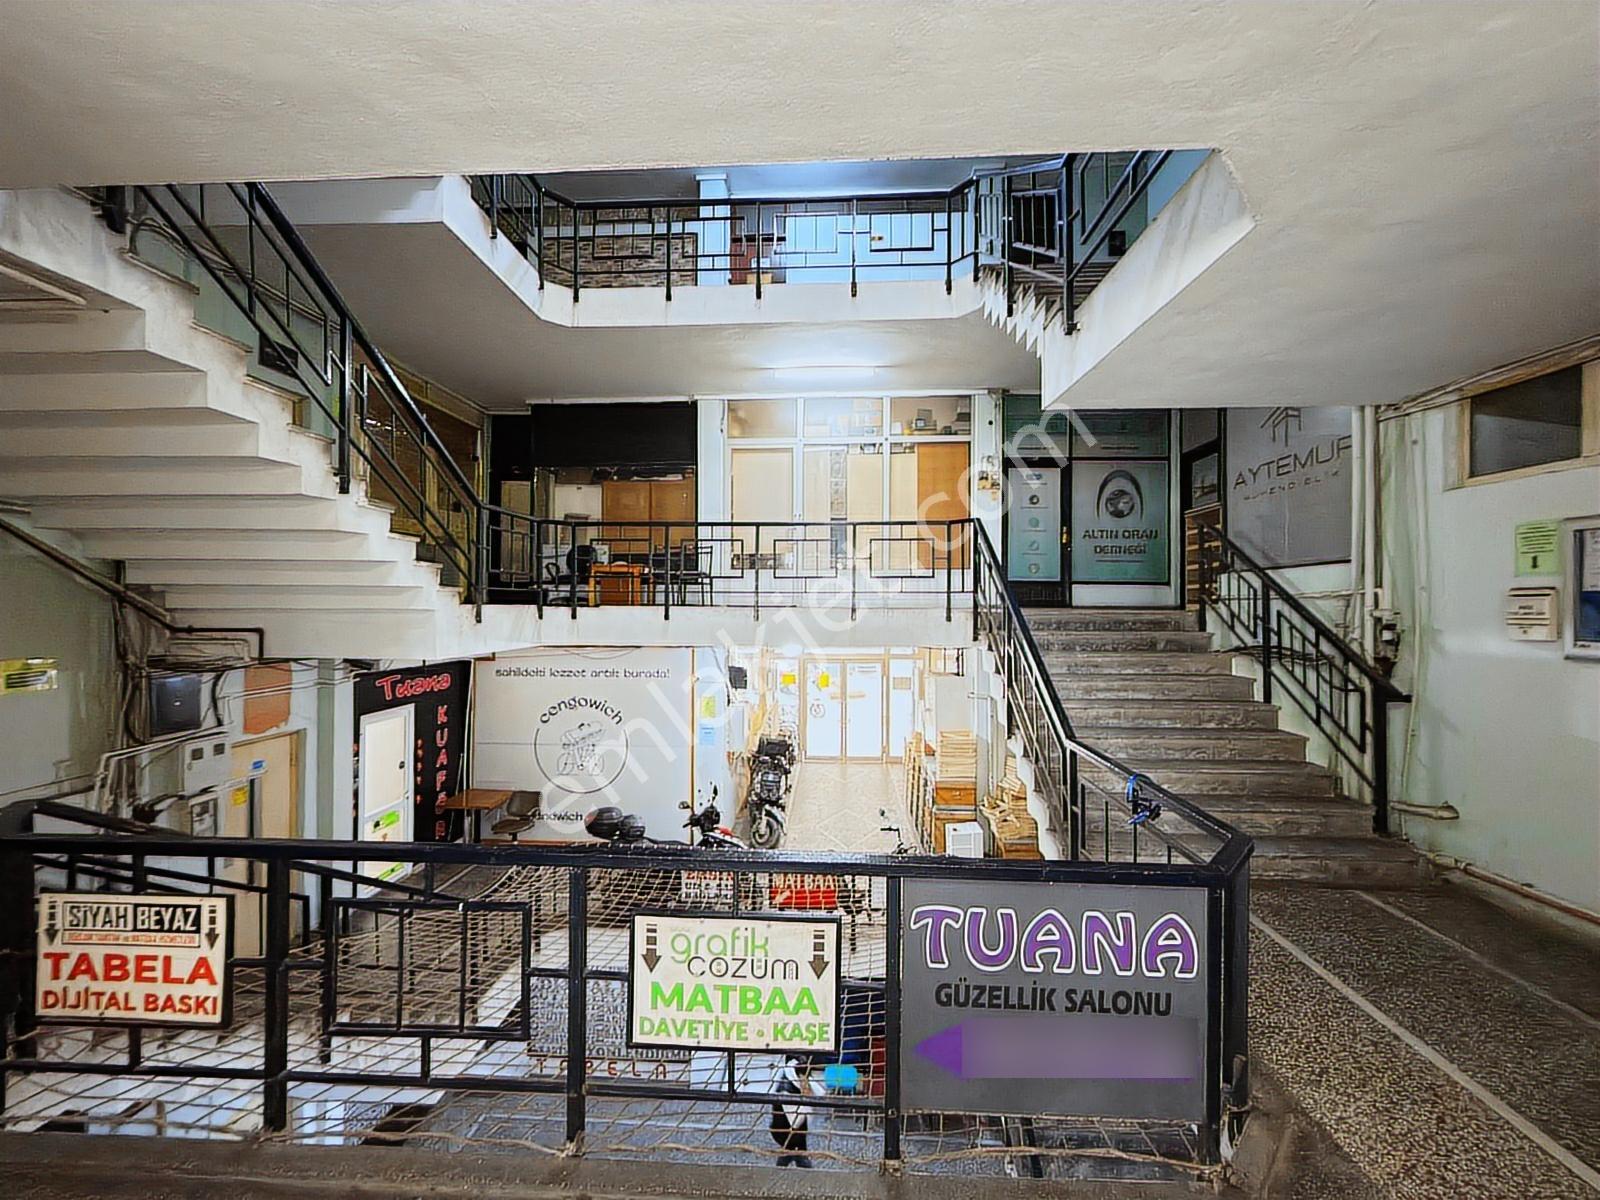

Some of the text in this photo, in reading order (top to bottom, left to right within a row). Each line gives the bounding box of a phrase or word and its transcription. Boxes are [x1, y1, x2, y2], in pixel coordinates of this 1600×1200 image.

[1083, 528, 1159, 540] ALTIN ORAN
[375, 673, 451, 701] Tuana
[623, 668, 670, 679] burada!
[136, 906, 198, 932] BEYAZ
[670, 926, 769, 965] grafik
[910, 904, 1199, 979] TUANA
[43, 951, 218, 986] TABELA
[41, 986, 219, 1016] DİJİTAL BASKI
[650, 980, 820, 1016] MATBAA
[934, 977, 1172, 1017] GÜZELLİK SALONU
[639, 1015, 831, 1046] DAVETİYE KAŞE
